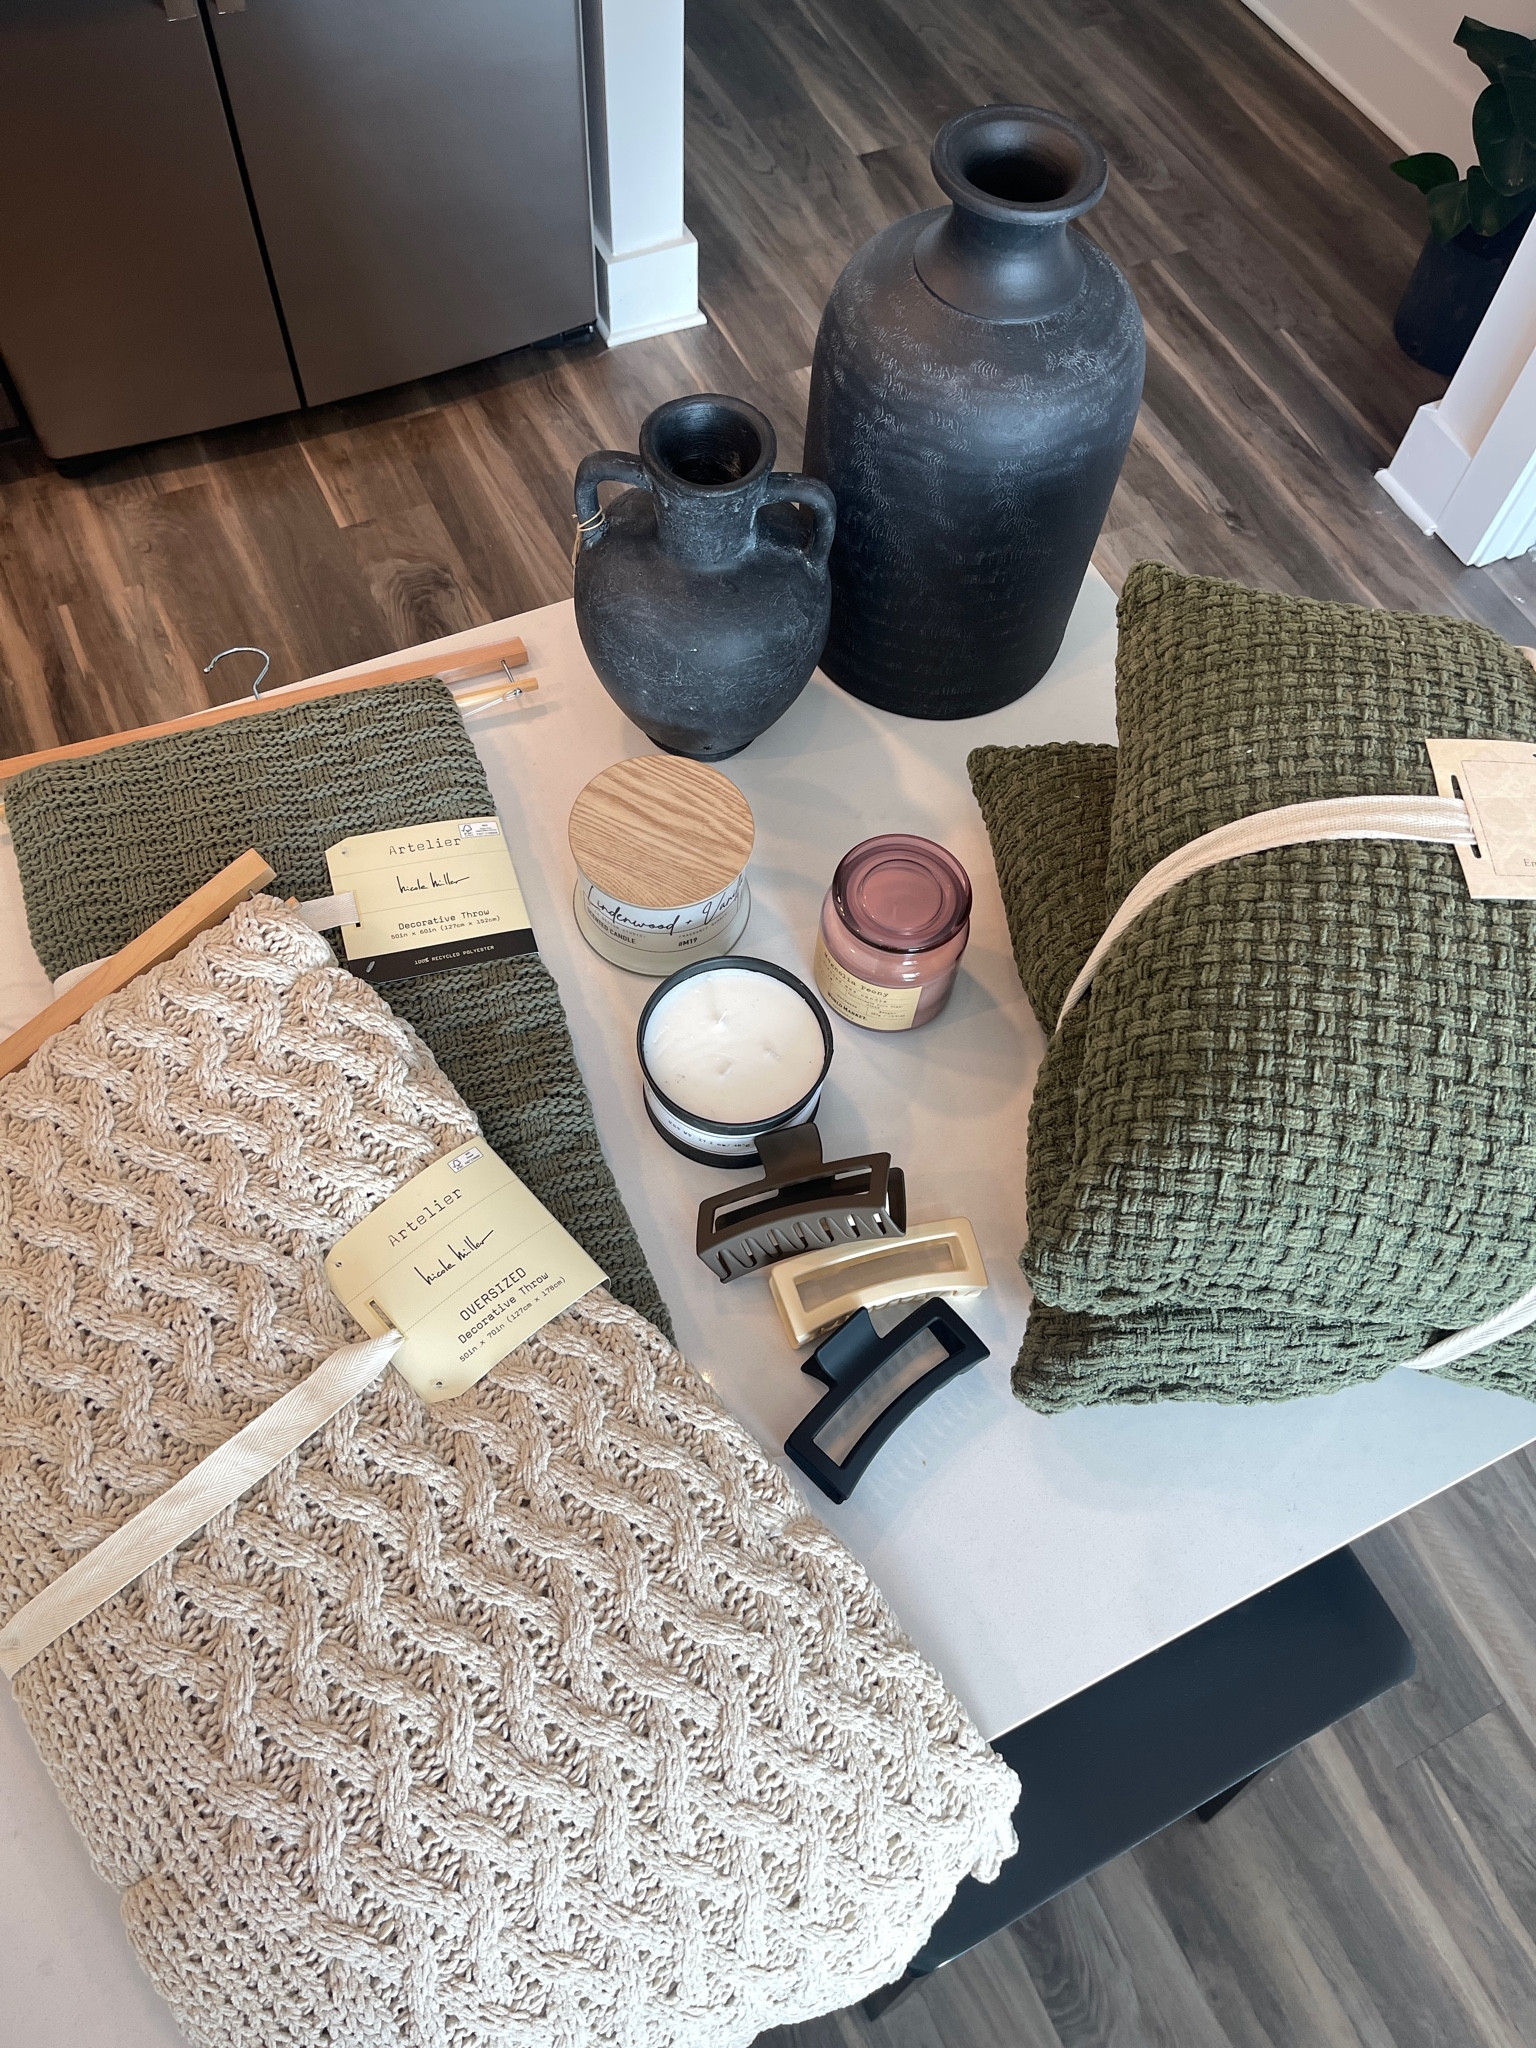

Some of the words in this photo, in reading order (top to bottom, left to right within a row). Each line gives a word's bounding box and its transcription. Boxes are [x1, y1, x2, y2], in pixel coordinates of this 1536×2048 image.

[389, 836, 462, 856] Artelier
[390, 931, 409, 940] 50in
[419, 927, 437, 936] 60in
[440, 923, 466, 934] (127cm
[476, 916, 501, 925] 152cm)
[398, 914, 456, 932] Decorative
[461, 908, 490, 920] Throw
[609, 926, 636, 945] CANDLE
[678, 937, 698, 947] #M19
[414, 956, 430, 965] 100%
[431, 951, 461, 962] RECYCLED
[462, 945, 495, 957] POLYESTER
[860, 984, 889, 998] Peony
[387, 1186, 463, 1247] Artelier
[459, 1266, 527, 1321] OVERSIZED
[458, 1294, 517, 1344] Decorative
[518, 1272, 550, 1295] Throw
[459, 1345, 478, 1362] 50in
[487, 1322, 505, 1338] 70in
[506, 1301, 532, 1324] (127cm
[541, 1276, 566, 1297] 178cm)
